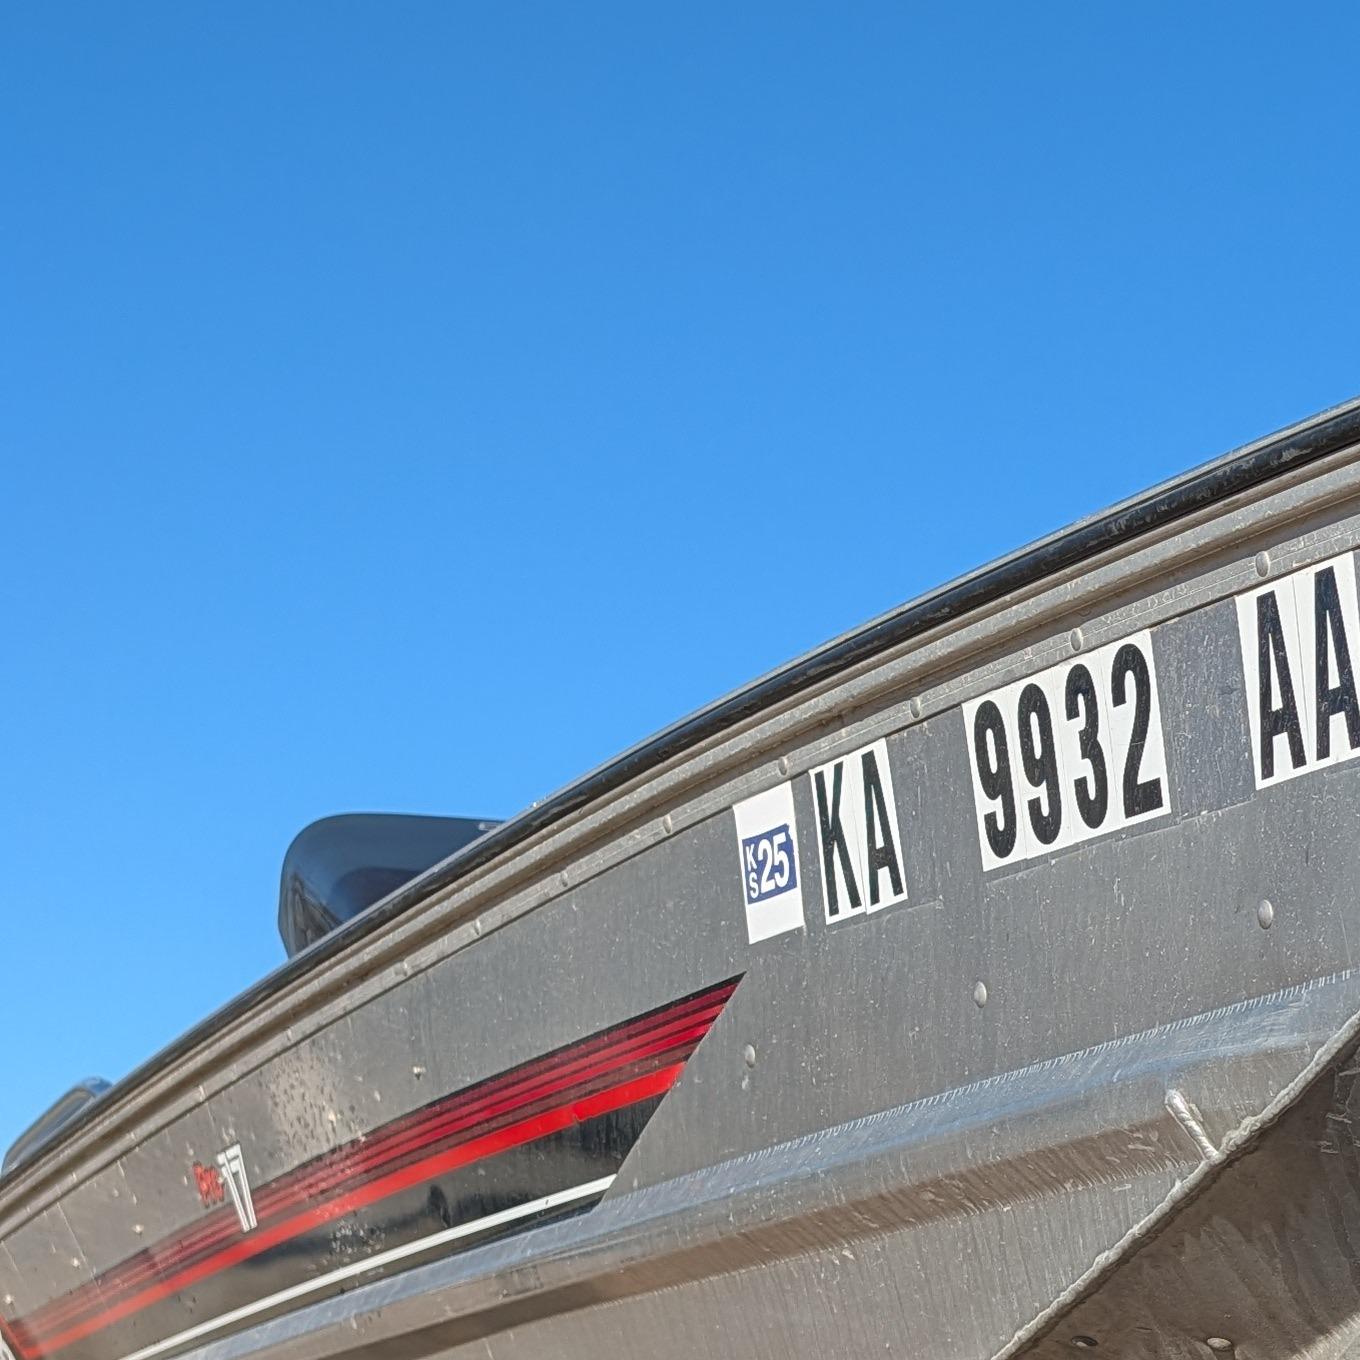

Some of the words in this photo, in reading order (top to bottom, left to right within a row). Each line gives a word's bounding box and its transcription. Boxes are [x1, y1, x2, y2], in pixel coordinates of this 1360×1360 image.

[758, 832, 789, 894] 25
[814, 750, 904, 916] KA
[973, 643, 1163, 858] 9932
